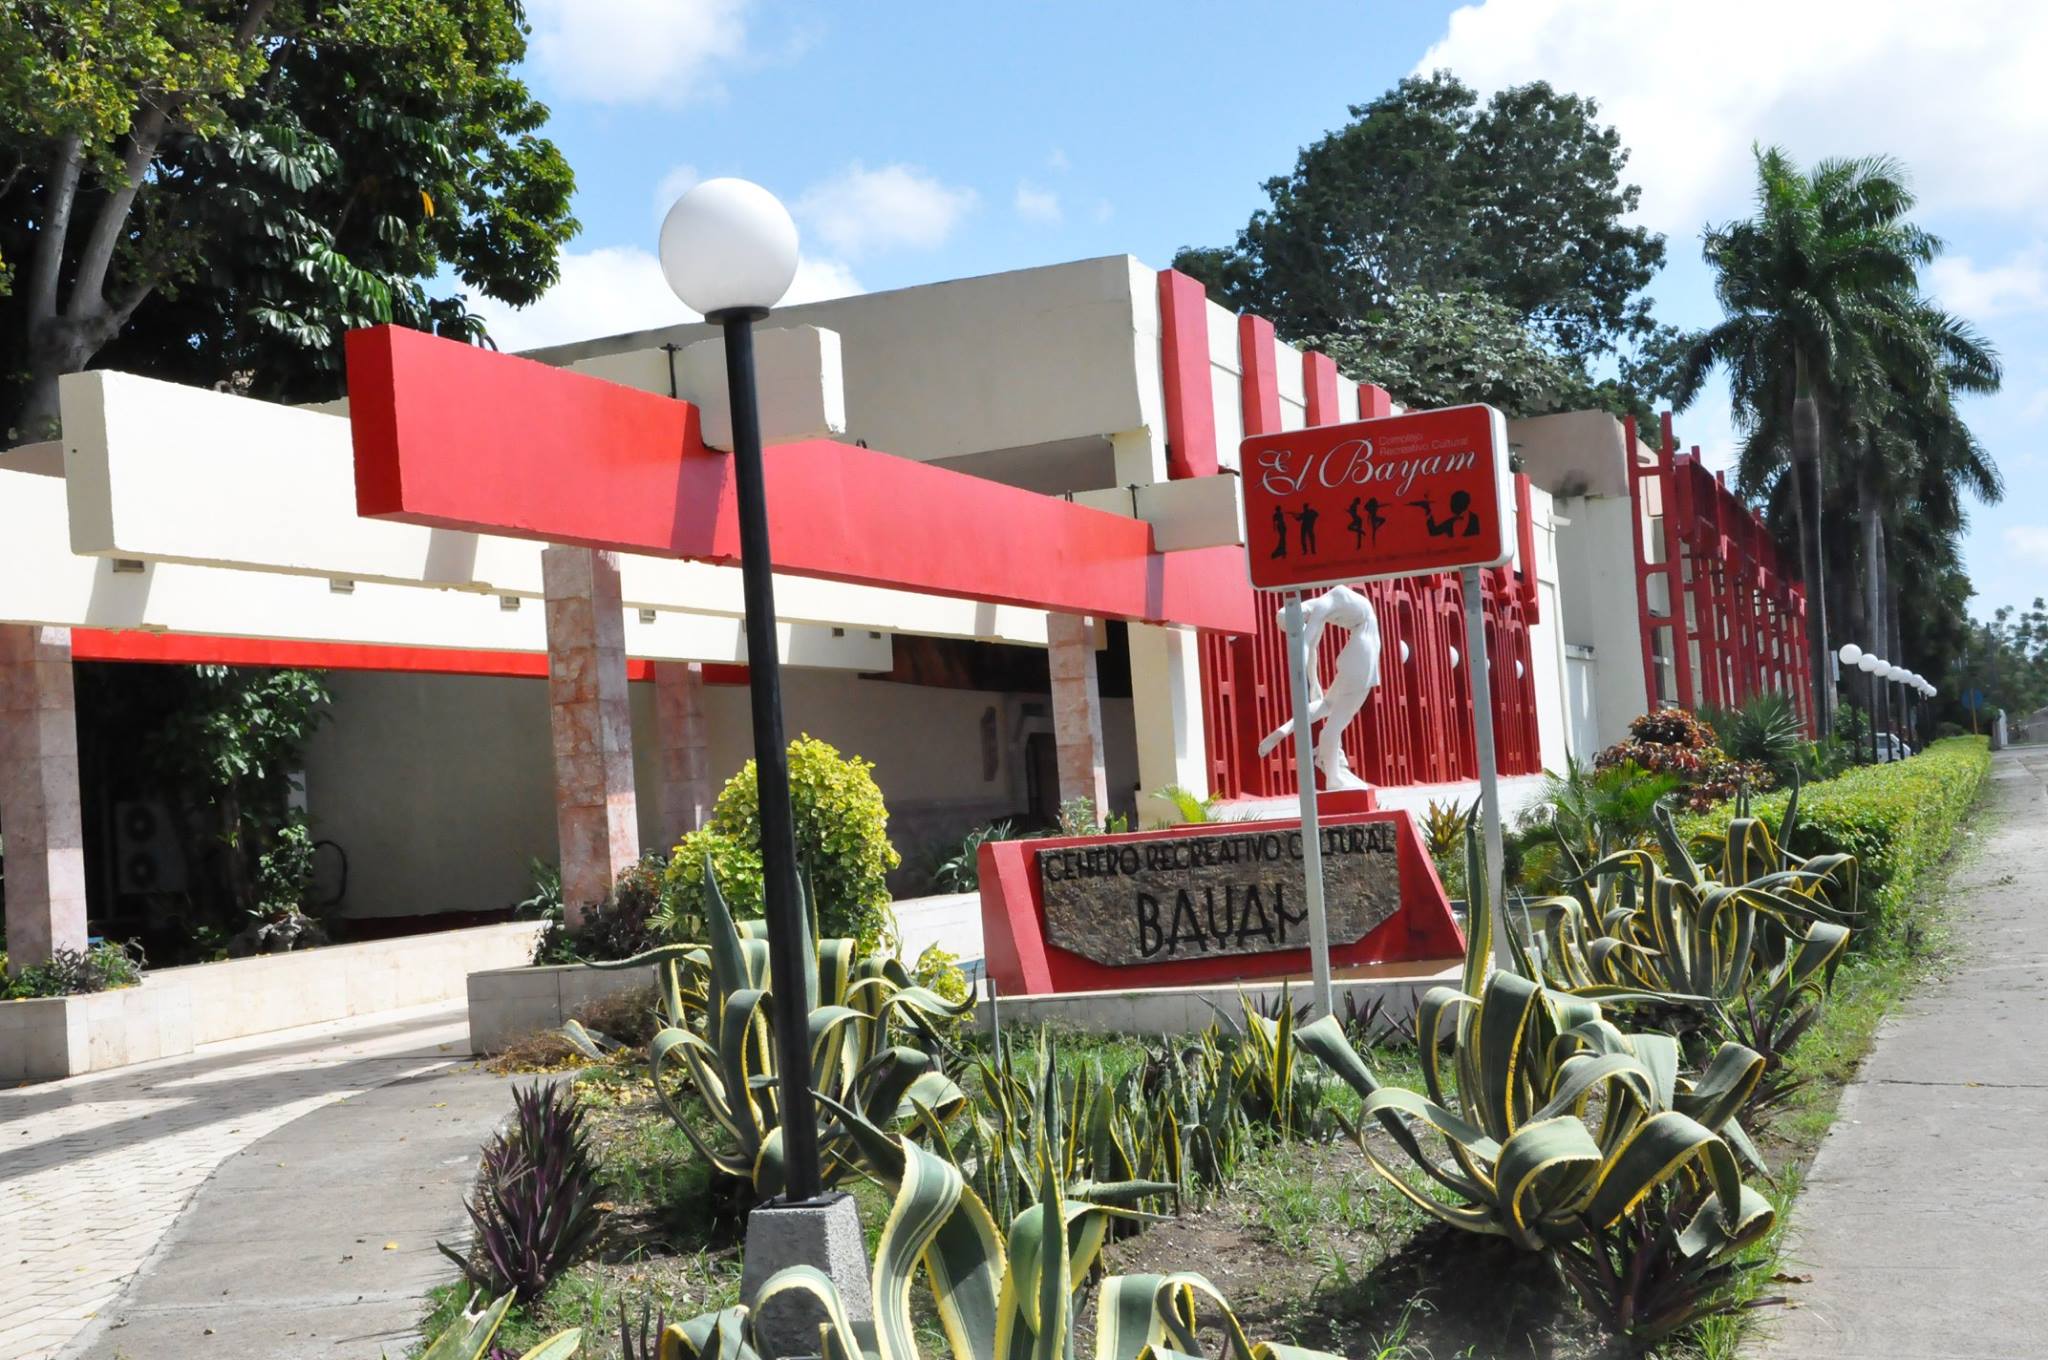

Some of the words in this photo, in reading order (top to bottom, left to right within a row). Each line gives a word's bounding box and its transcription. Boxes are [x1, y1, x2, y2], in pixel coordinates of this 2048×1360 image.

[1255, 450, 1314, 496] El
[1319, 438, 1475, 497] Bayam
[1046, 846, 1140, 882] CENTRO
[1147, 835, 1281, 871] RECREATIVO
[1288, 827, 1395, 860] CLTURAL
